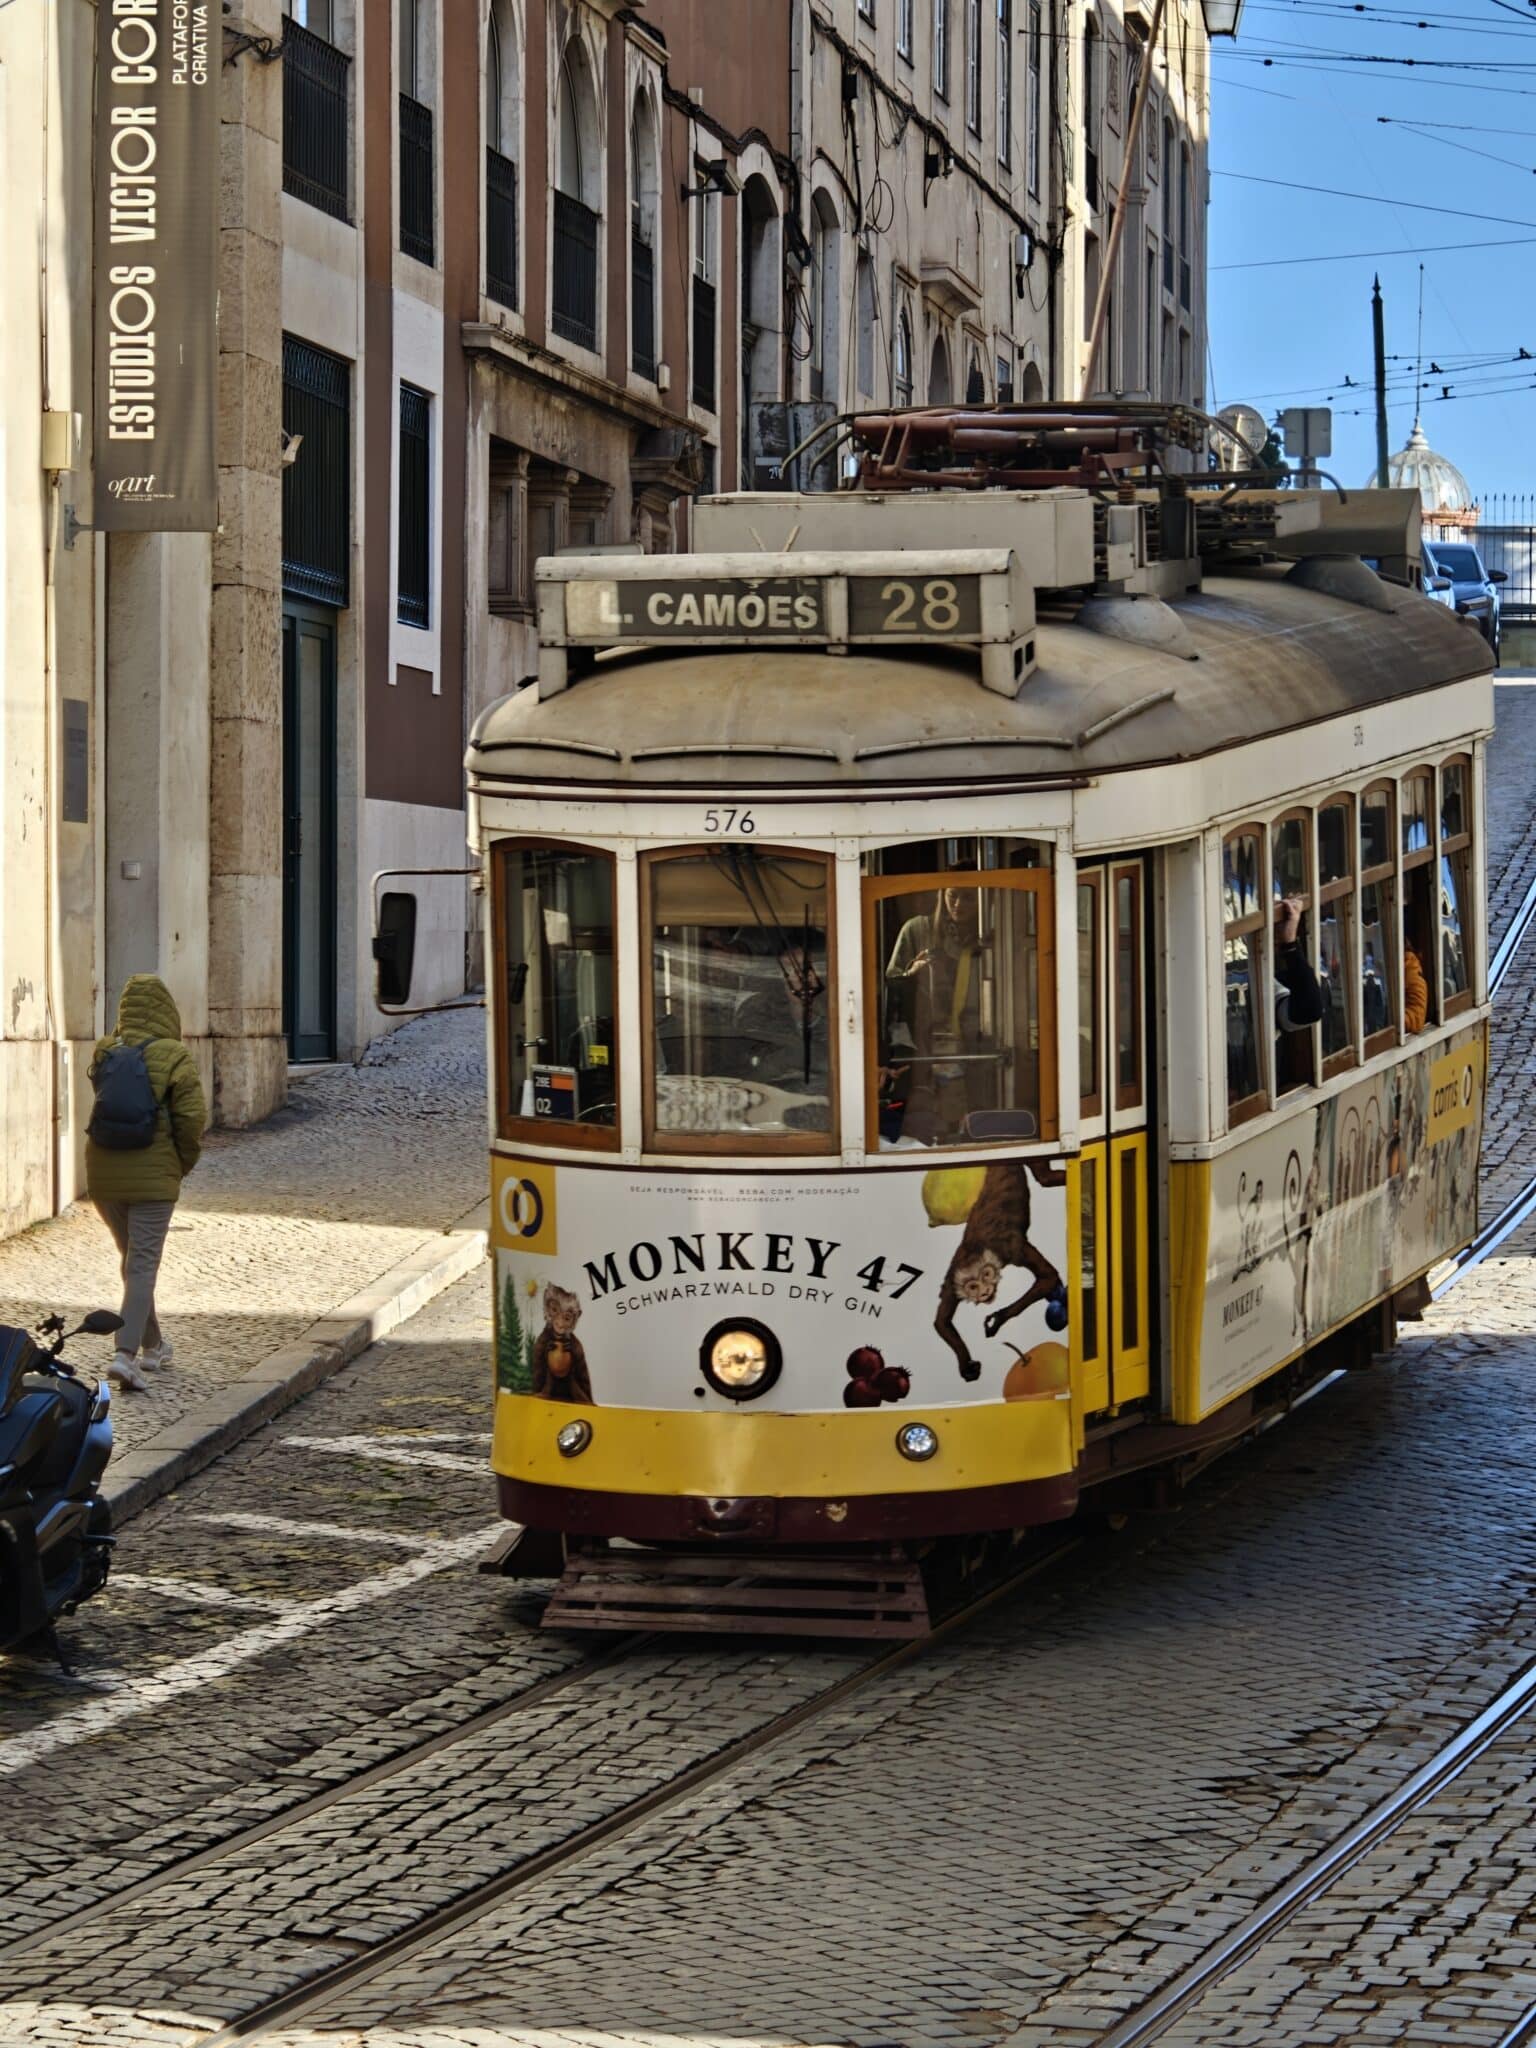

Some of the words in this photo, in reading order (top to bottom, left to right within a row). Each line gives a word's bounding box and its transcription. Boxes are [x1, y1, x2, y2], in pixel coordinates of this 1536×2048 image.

[192, 5, 208, 85] CRIATIVA
[110, 106, 157, 243] VICTOR
[600, 590, 634, 624] L.
[647, 591, 818, 630] CAMÕES
[881, 580, 960, 631] 28
[704, 809, 755, 834] 576
[535, 1098, 552, 1114] 02
[583, 1232, 841, 1301] MONKEY
[856, 1255, 925, 1300] 47
[615, 1282, 776, 1316] SCHWARZWALD
[788, 1285, 834, 1302] DRY
[844, 1296, 883, 1319] GIN
